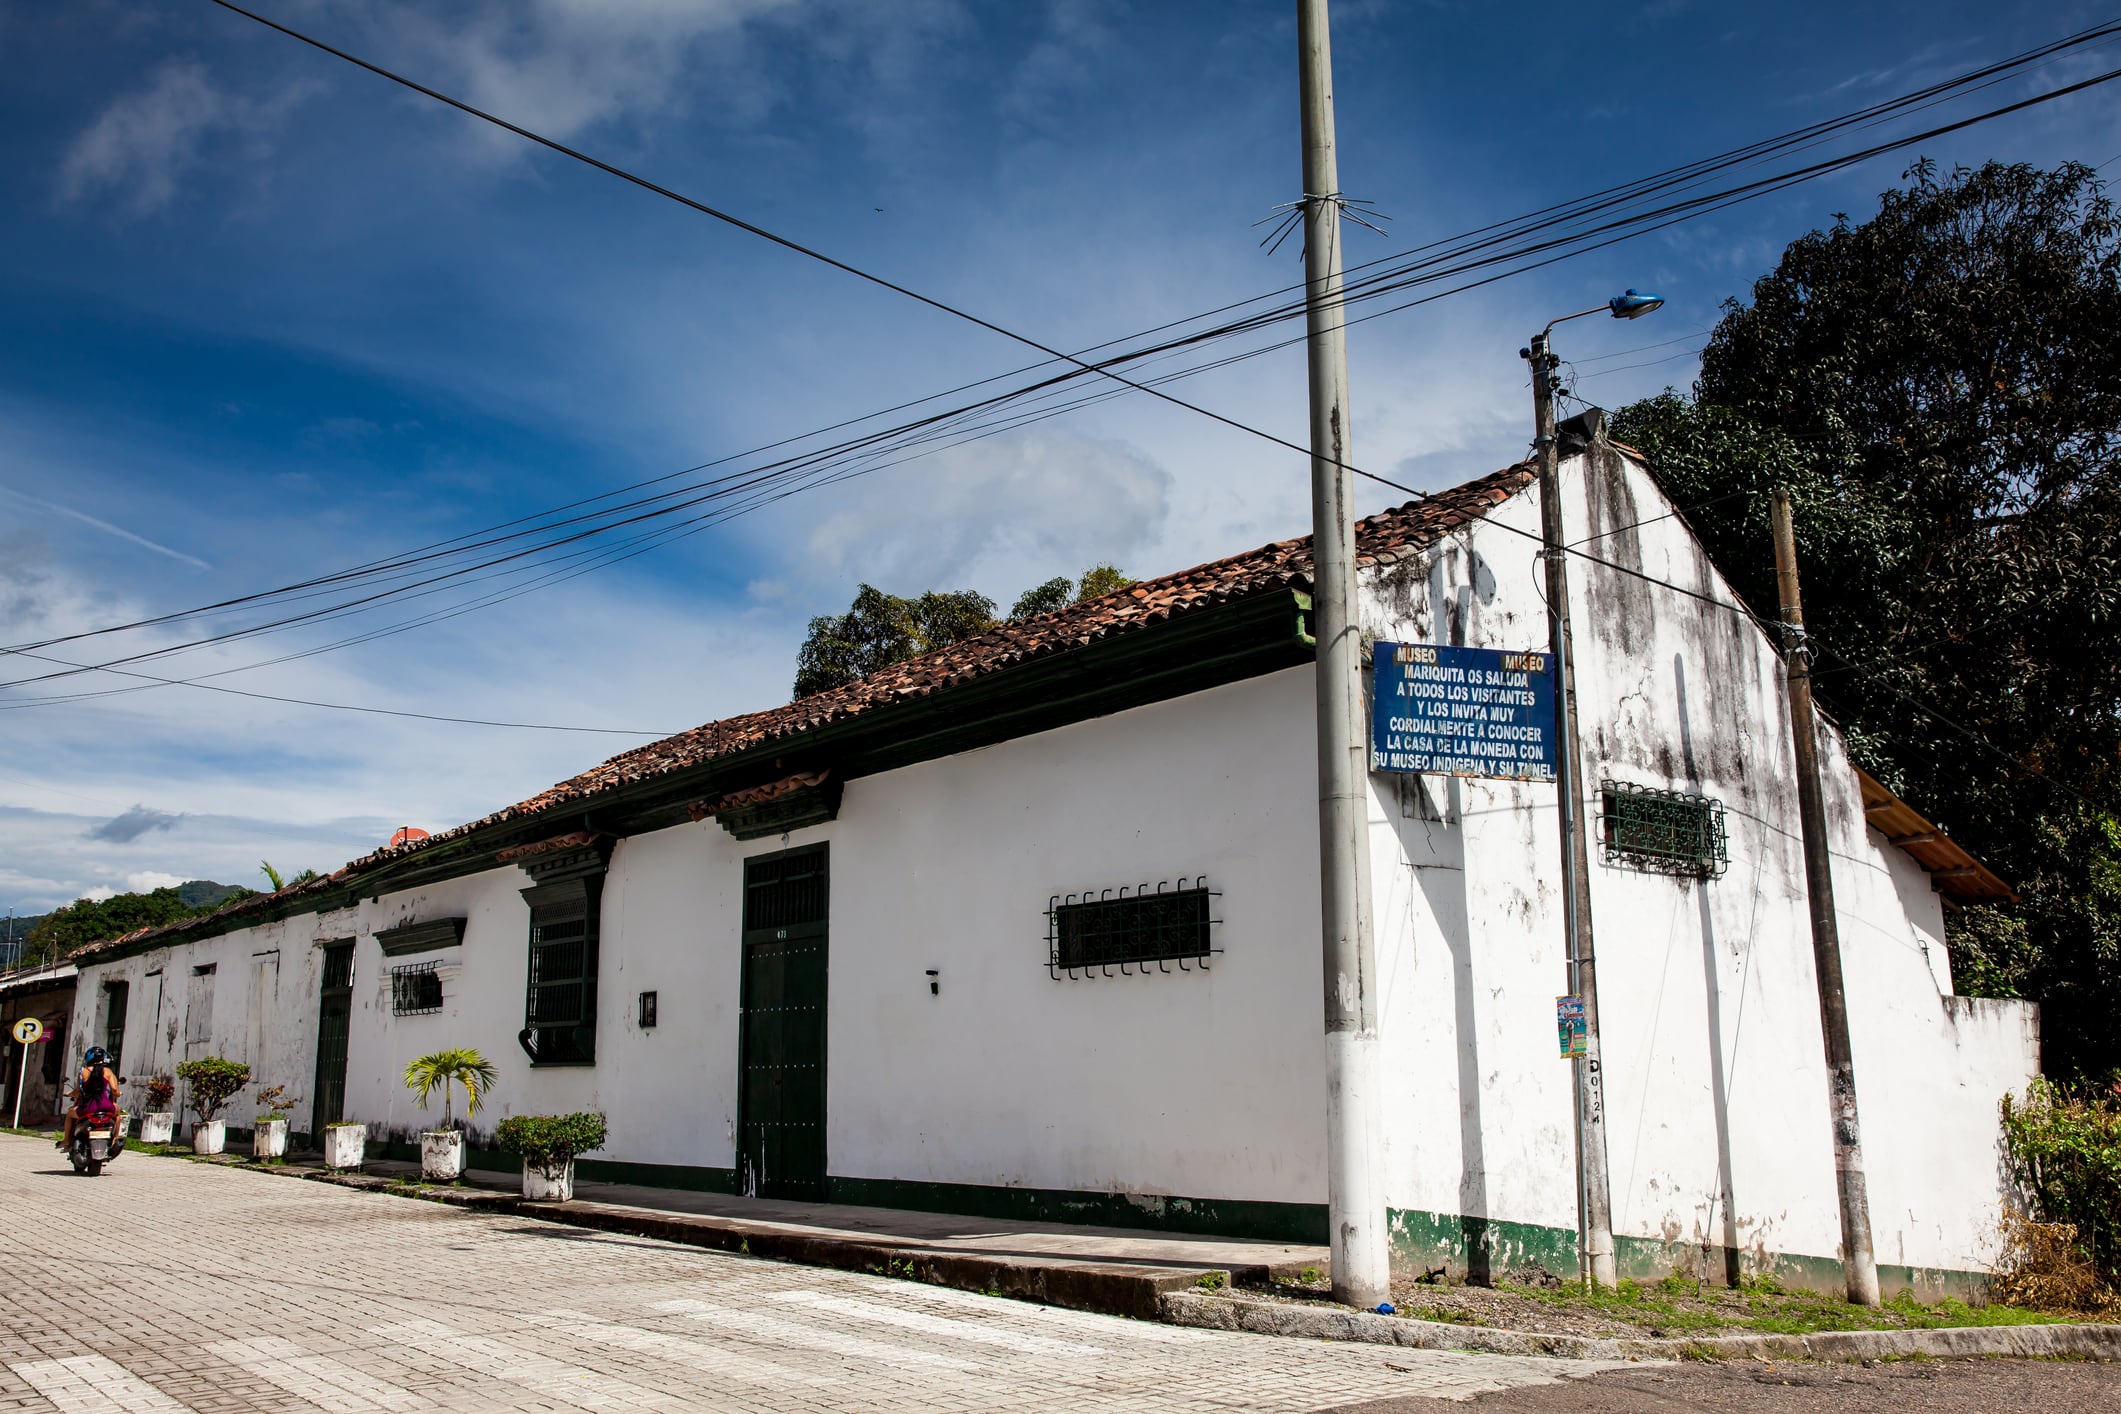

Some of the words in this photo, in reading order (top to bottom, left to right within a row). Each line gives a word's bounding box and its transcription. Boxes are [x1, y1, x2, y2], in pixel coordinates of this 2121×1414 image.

[1397, 647, 1436, 663] MUSEO
[1505, 655, 1544, 671] MUSEO
[1404, 664, 1465, 682] MARIQUITA
[1468, 669, 1483, 684] OS
[1485, 671, 1528, 687] SALUDA
[1397, 681, 1405, 696] A
[1408, 682, 1445, 699] TODOS
[1448, 685, 1469, 701] LOS
[1471, 687, 1535, 706] VISITANTES
[1417, 701, 1424, 715] Y
[1427, 702, 1449, 717] LOS
[1451, 703, 1487, 721] INVITA
[1490, 706, 1514, 722] MUY
[1389, 716, 1475, 737] CORDIALMENTE
[1477, 724, 1485, 738] A
[1488, 724, 1542, 742] CONOCER
[1387, 734, 1401, 750] LA
[1404, 735, 1434, 752] CASA
[1437, 738, 1451, 754] DE
[1454, 739, 1468, 755] LA
[1470, 740, 1517, 759] MONEDA
[1520, 744, 1543, 760] CON
[1374, 752, 1388, 767] SU
[1390, 753, 1430, 770] MUSEO
[1432, 756, 1486, 774] INDIGENA
[1488, 760, 1496, 774] Y
[1499, 760, 1514, 776] SU
[22, 1022, 37, 1039] P
